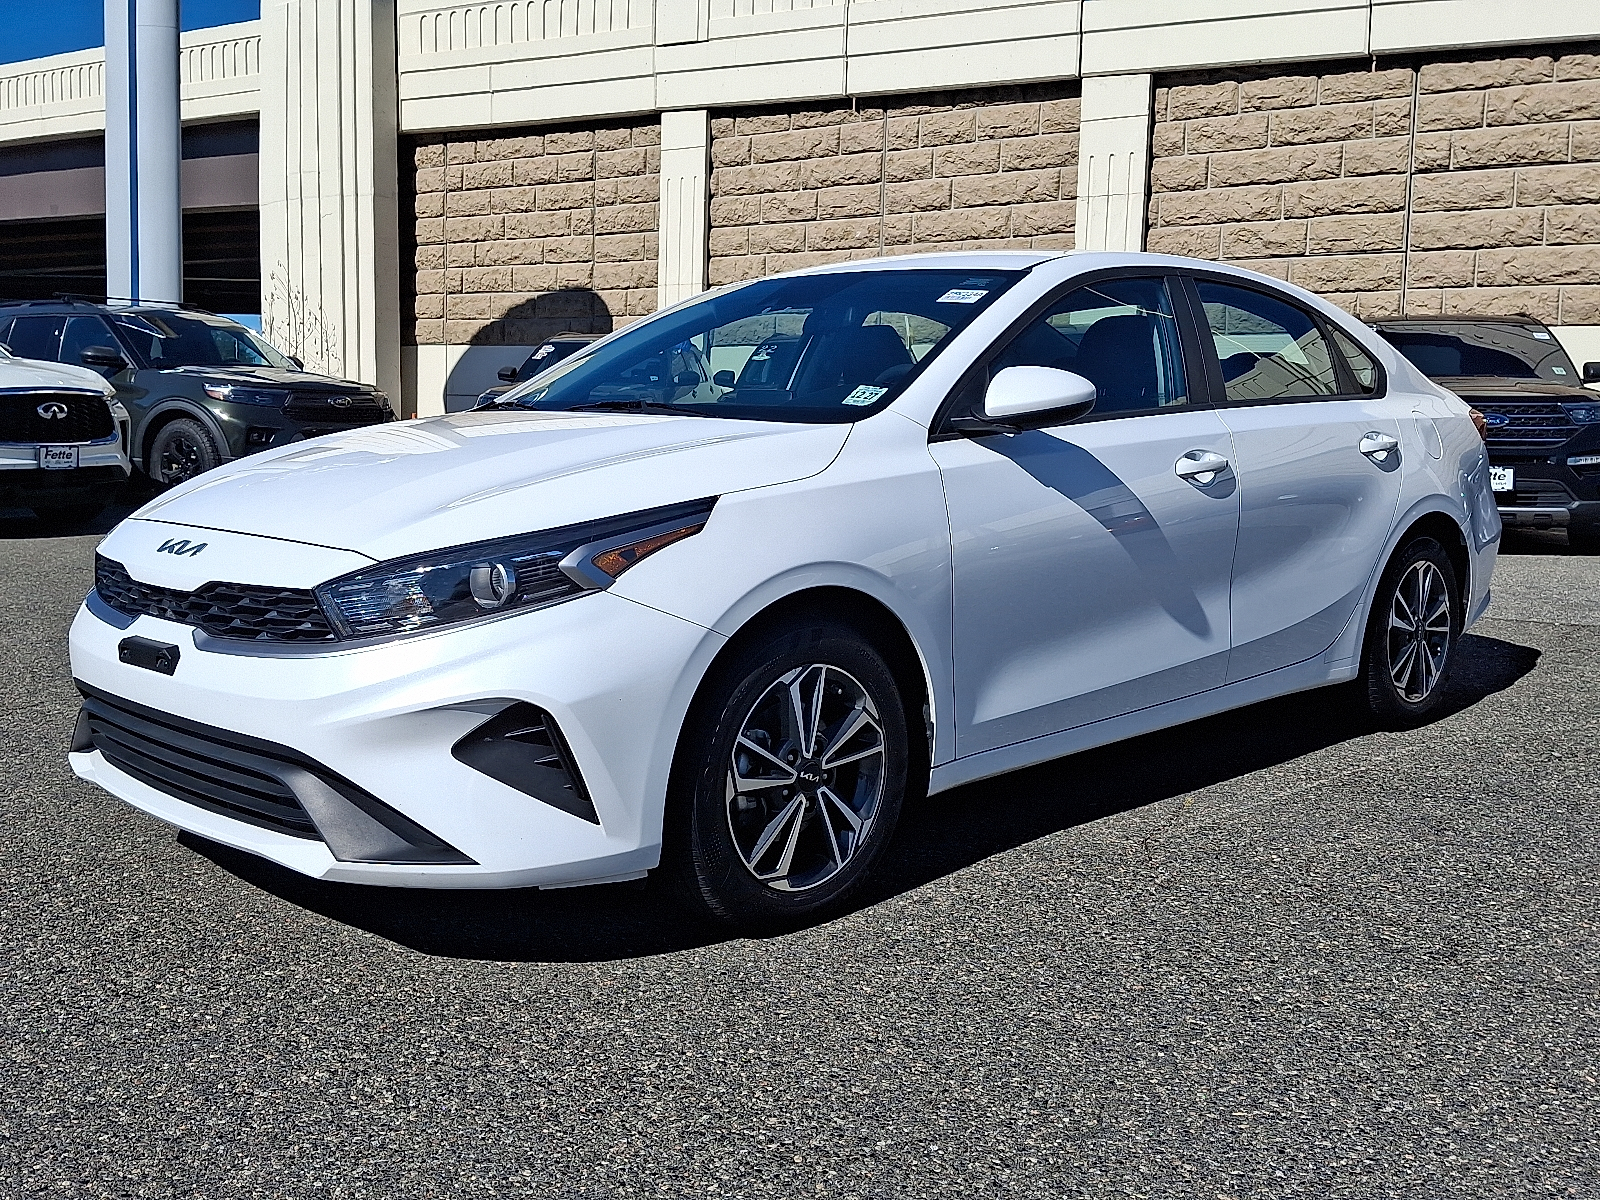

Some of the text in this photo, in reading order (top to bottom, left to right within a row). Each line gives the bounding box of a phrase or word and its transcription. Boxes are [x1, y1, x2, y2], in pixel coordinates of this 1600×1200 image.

[44, 449, 73, 460] Fette
[156, 537, 209, 558] KIA
[800, 771, 820, 783] KIA
